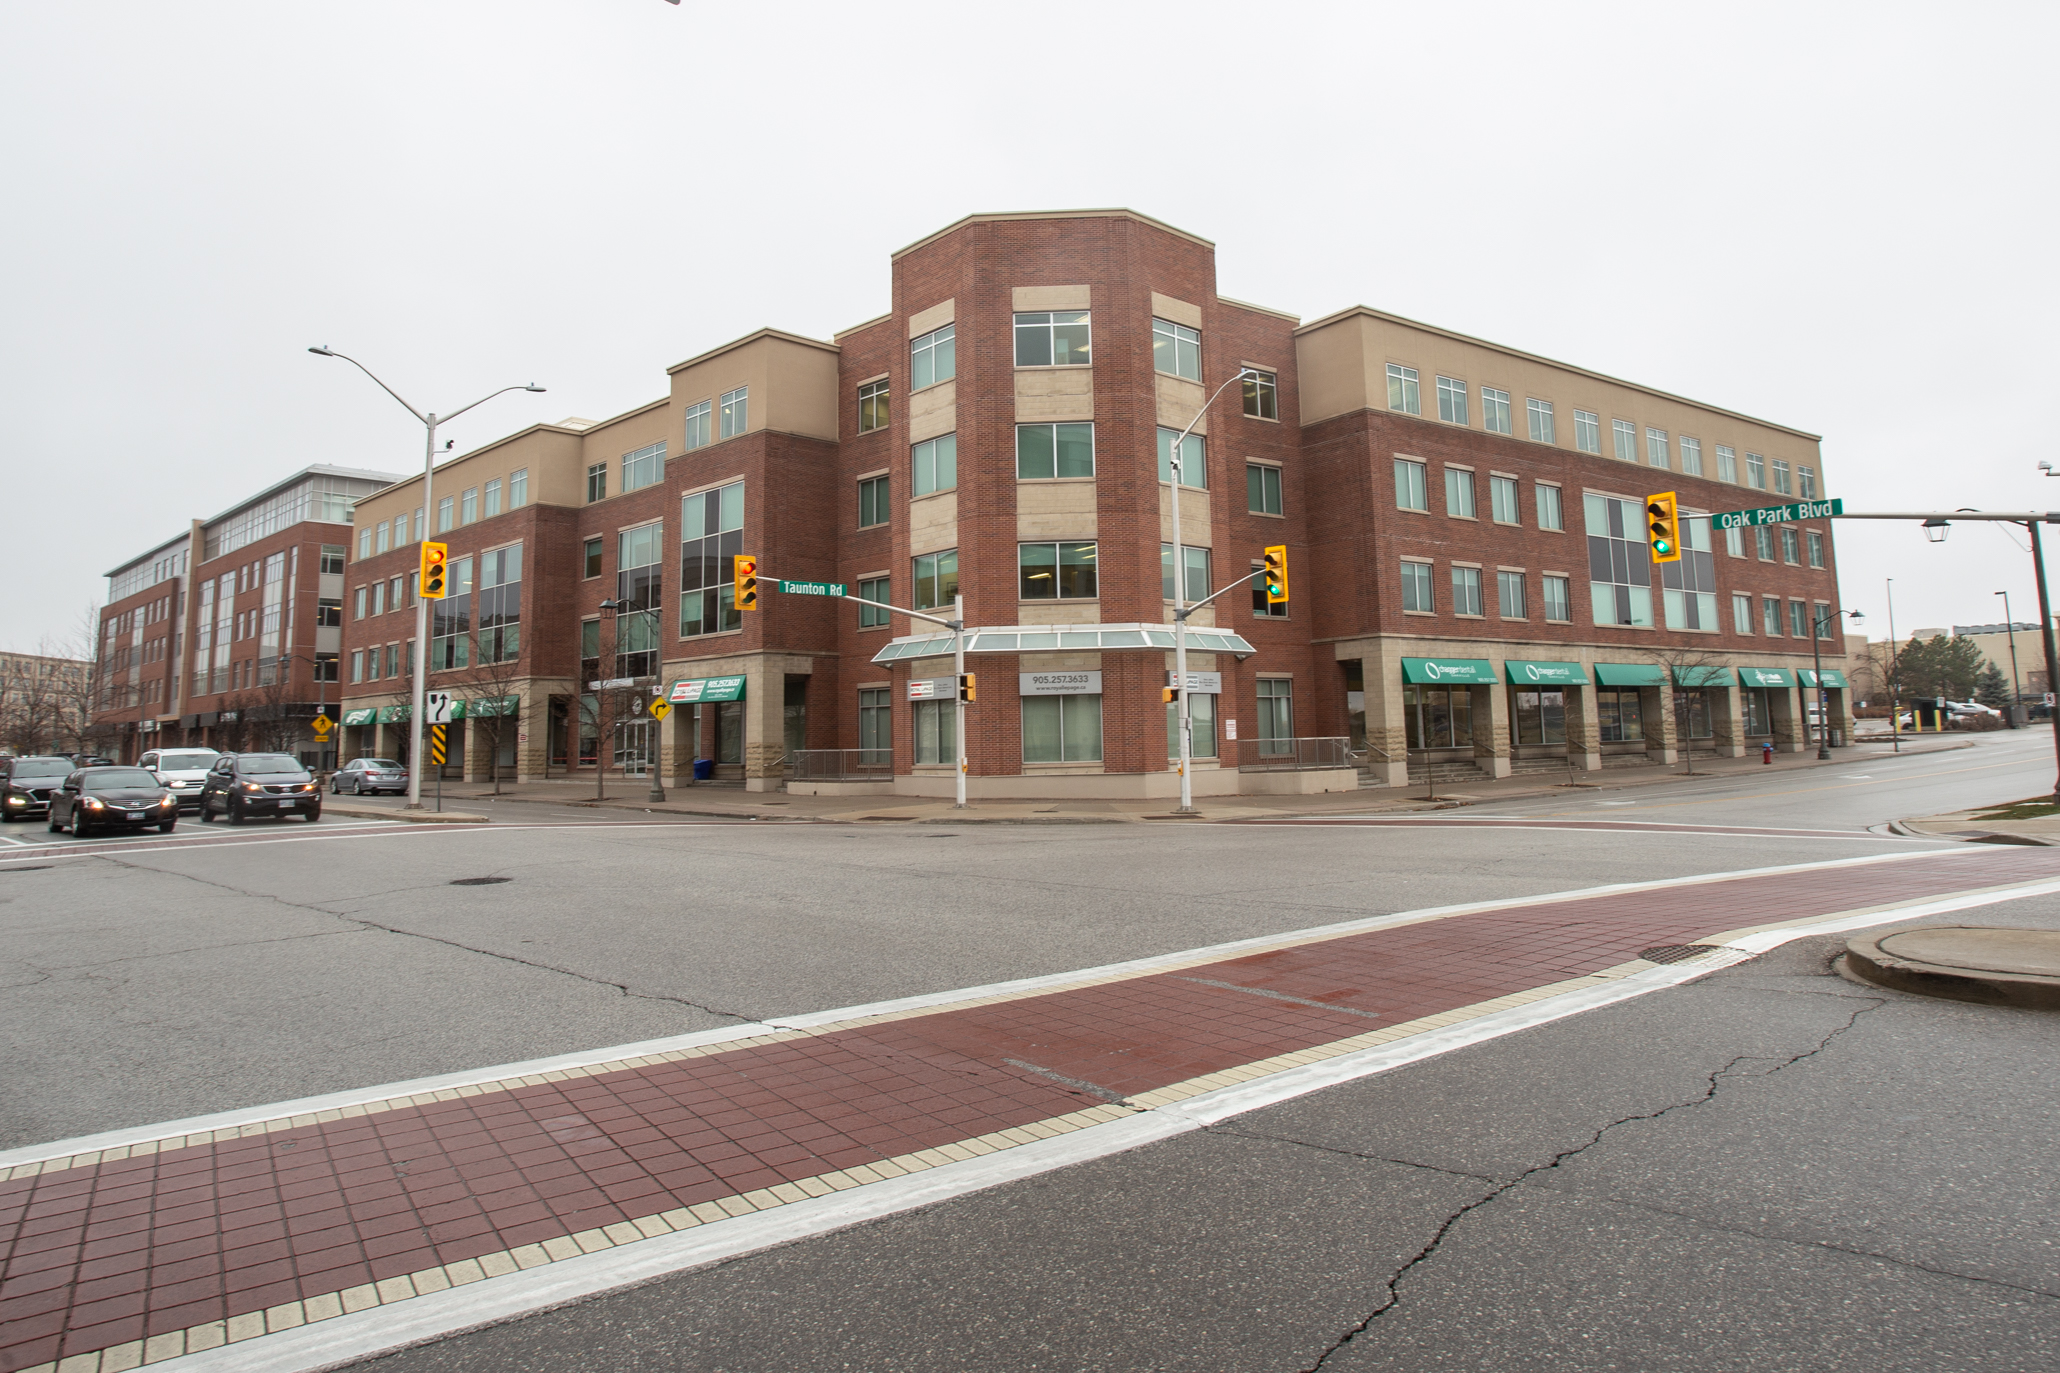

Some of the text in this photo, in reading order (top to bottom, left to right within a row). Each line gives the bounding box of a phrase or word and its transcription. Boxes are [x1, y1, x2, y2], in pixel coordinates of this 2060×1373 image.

[1721, 499, 1833, 528] Oak Park Blvd
[784, 581, 843, 596] Taunton Rd
[1032, 675, 1089, 684] 905.257.3633
